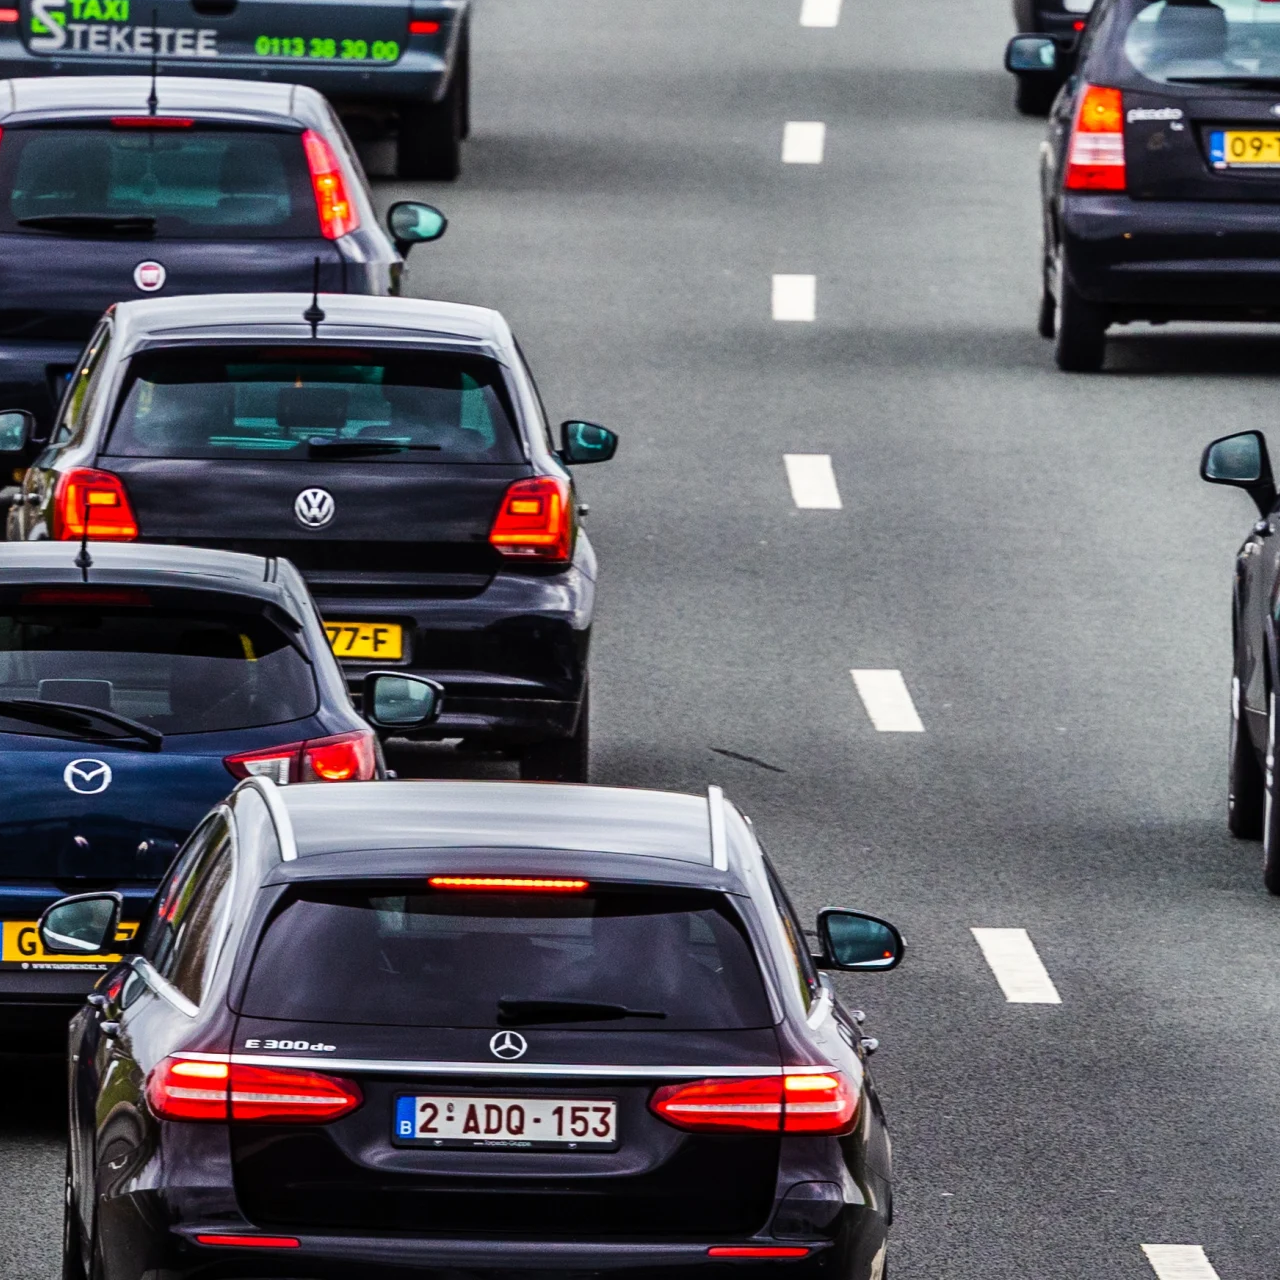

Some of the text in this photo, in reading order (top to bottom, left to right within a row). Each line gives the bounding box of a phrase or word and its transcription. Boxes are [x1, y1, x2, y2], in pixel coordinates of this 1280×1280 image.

[255, 36, 305, 58] 0113
[341, 39, 368, 60] 30
[371, 40, 400, 61] 00
[245, 1039, 262, 1049] E
[400, 1121, 412, 1135] B
